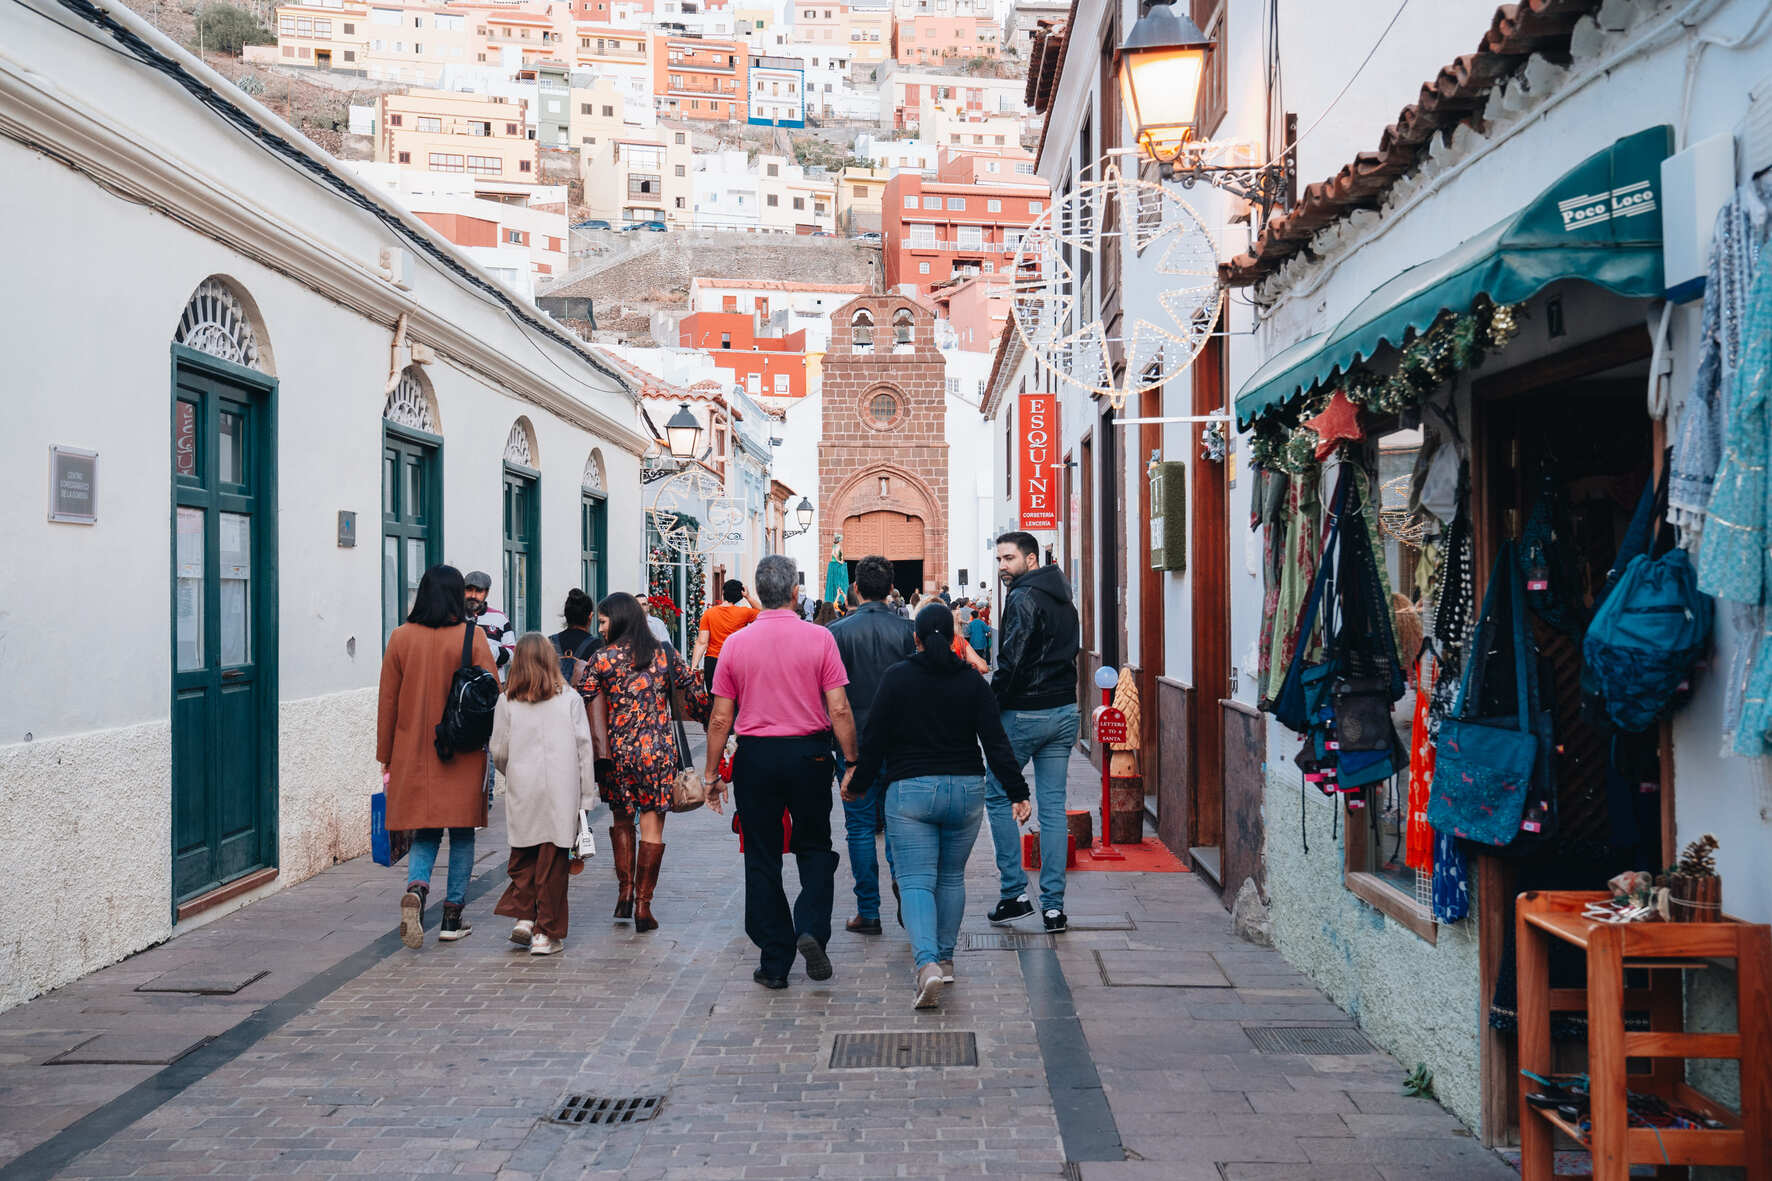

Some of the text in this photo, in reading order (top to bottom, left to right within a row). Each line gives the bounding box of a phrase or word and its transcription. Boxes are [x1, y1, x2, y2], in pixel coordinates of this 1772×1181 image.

[1562, 190, 1654, 224] Poco Loco
[1027, 399, 1048, 509] ESQUINE
